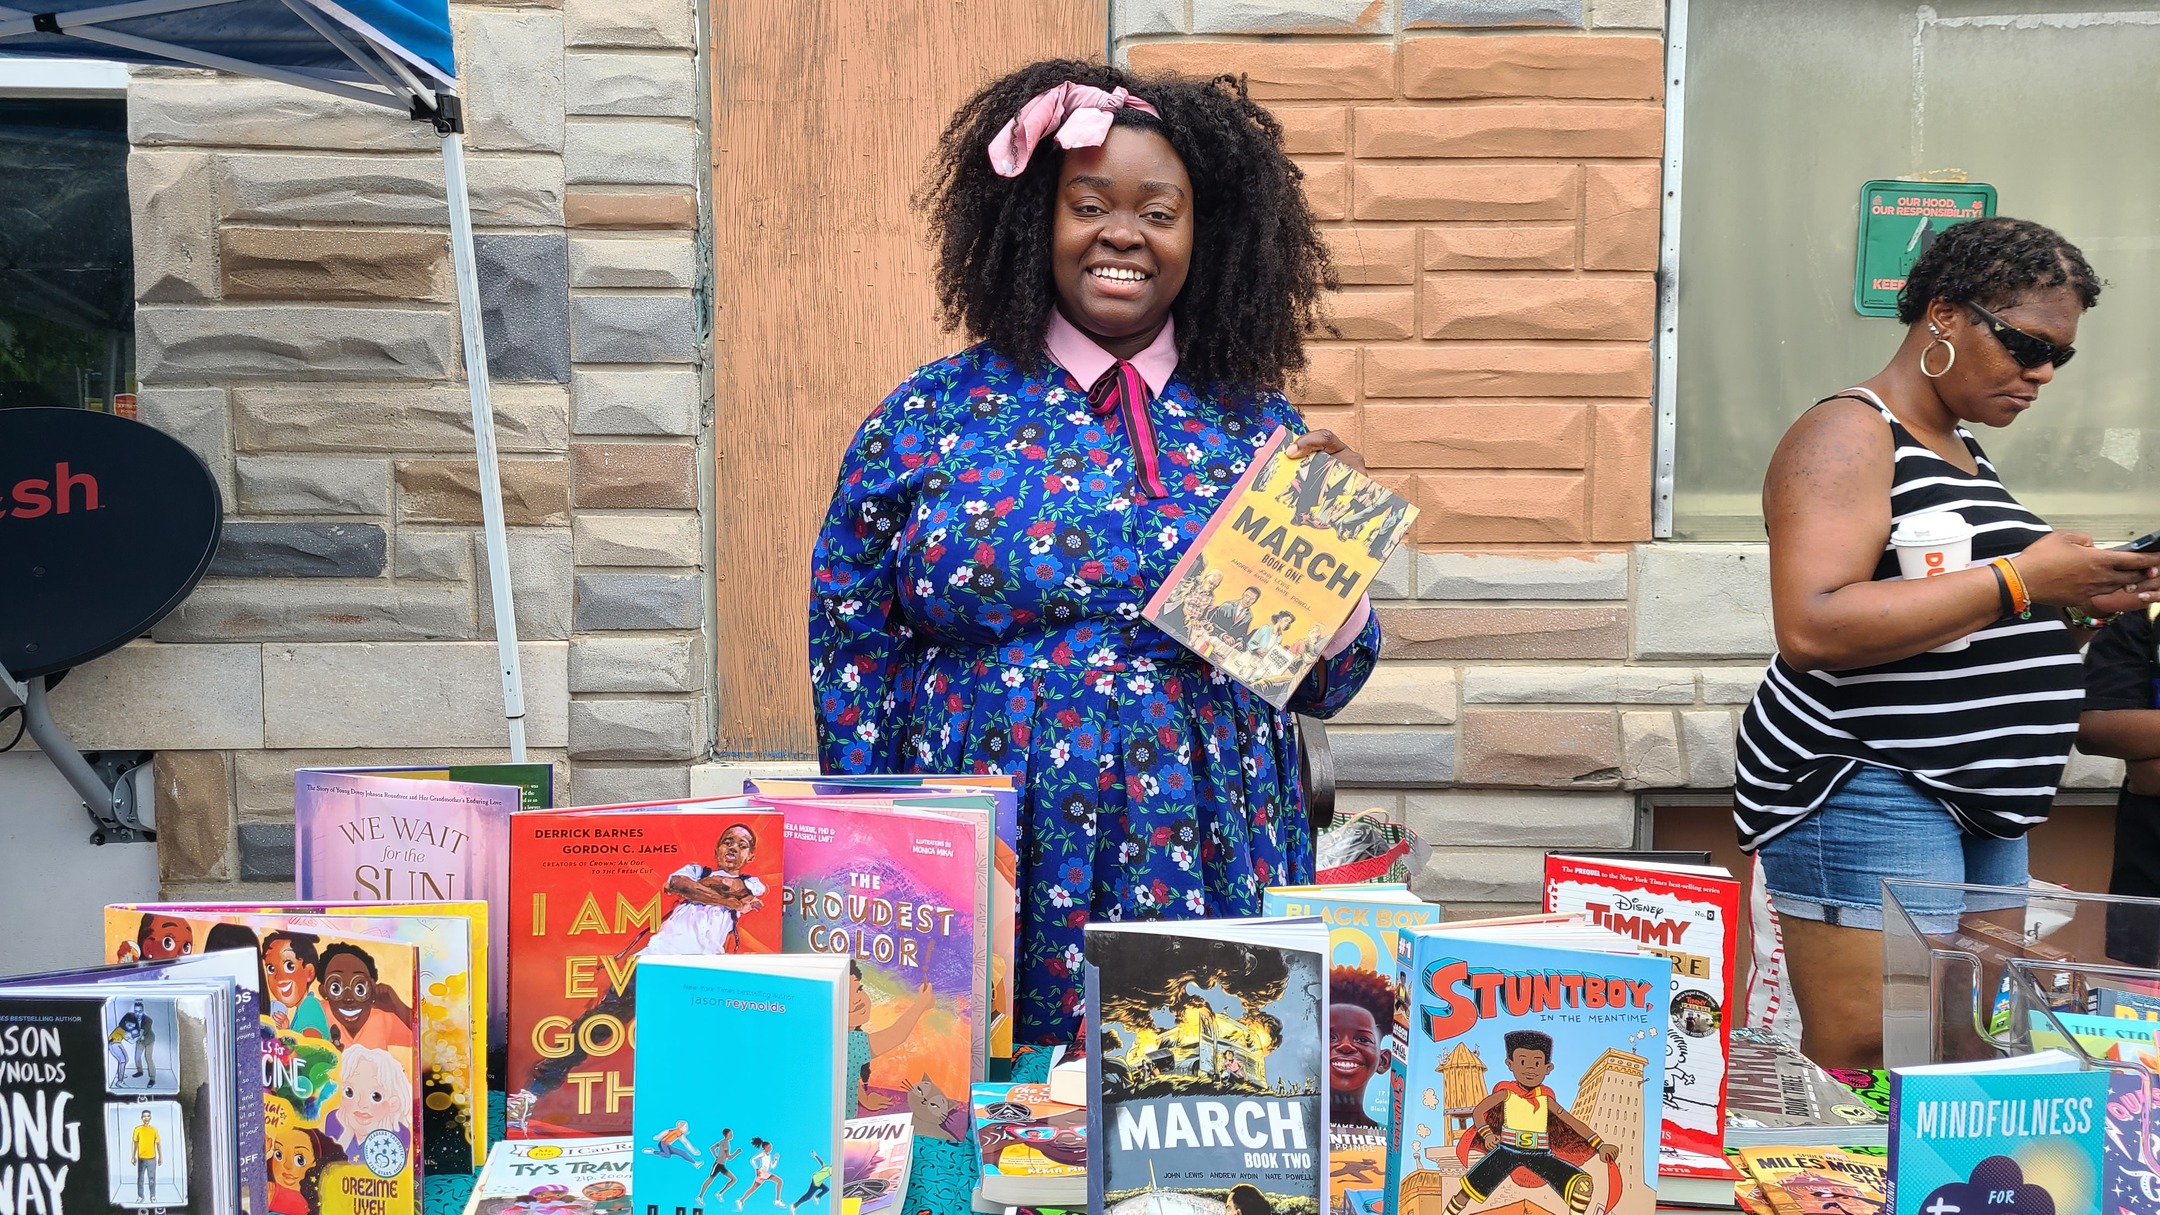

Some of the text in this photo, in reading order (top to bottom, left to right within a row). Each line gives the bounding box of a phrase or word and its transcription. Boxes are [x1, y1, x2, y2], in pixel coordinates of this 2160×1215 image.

[1872, 205, 1983, 218] OUR RESPONSIBILITY!
[1897, 197, 1957, 208] OUR HOOD,
[1872, 278, 1907, 290] KEEP
[1232, 505, 1361, 599] MARCH
[1261, 553, 1305, 585] BOOK ONE
[1231, 558, 1311, 611] ANDREW AYDIN NATE POWELL
[1259, 569, 1290, 590] JOHN LEWIS
[316, 785, 329, 793] Story
[335, 787, 350, 795] Young
[365, 790, 383, 798] Johnson
[466, 797, 489, 806] Enduring
[338, 815, 470, 855] WE WAIT
[535, 828, 644, 839] DERRICK BARNES
[380, 845, 425, 863] for the
[562, 844, 678, 854] GORDON C. JAMES
[912, 845, 954, 857] MONICA MIKAI
[849, 872, 881, 890] THE
[1575, 867, 1600, 877] PREQUEL
[1620, 874, 1633, 882] New
[1649, 878, 1667, 886] Times
[1668, 881, 1702, 892] best-selling
[532, 891, 662, 936] I AM
[783, 886, 955, 937] PROUDEST
[1376, 909, 1430, 928] BOY
[1694, 910, 1706, 918] No.
[1399, 937, 1413, 960] #1
[737, 990, 772, 998] bestselling
[1540, 1013, 1648, 1024] IN THE MEANTIME
[0, 1025, 62, 1057] SON
[531, 1013, 636, 1058] GO
[274, 1042, 285, 1055] for
[242, 1093, 254, 1101] and
[1014, 1086, 1038, 1094] the
[1780, 1074, 1809, 1117] BOOK THREE
[1890, 1097, 1898, 1131] ROBERTS
[1916, 1096, 2093, 1139] MINDFULNESS
[1115, 1100, 1308, 1151] MARCH
[578, 1146, 610, 1155] Can
[1335, 1144, 1376, 1152] PRINCE
[565, 1161, 633, 1174] TRAV
[1244, 1152, 1311, 1168] BOOK TWO
[1757, 1158, 1826, 1170] MILES
[342, 1176, 398, 1198] OREZIME
[1988, 1190, 2015, 1205] FOR
